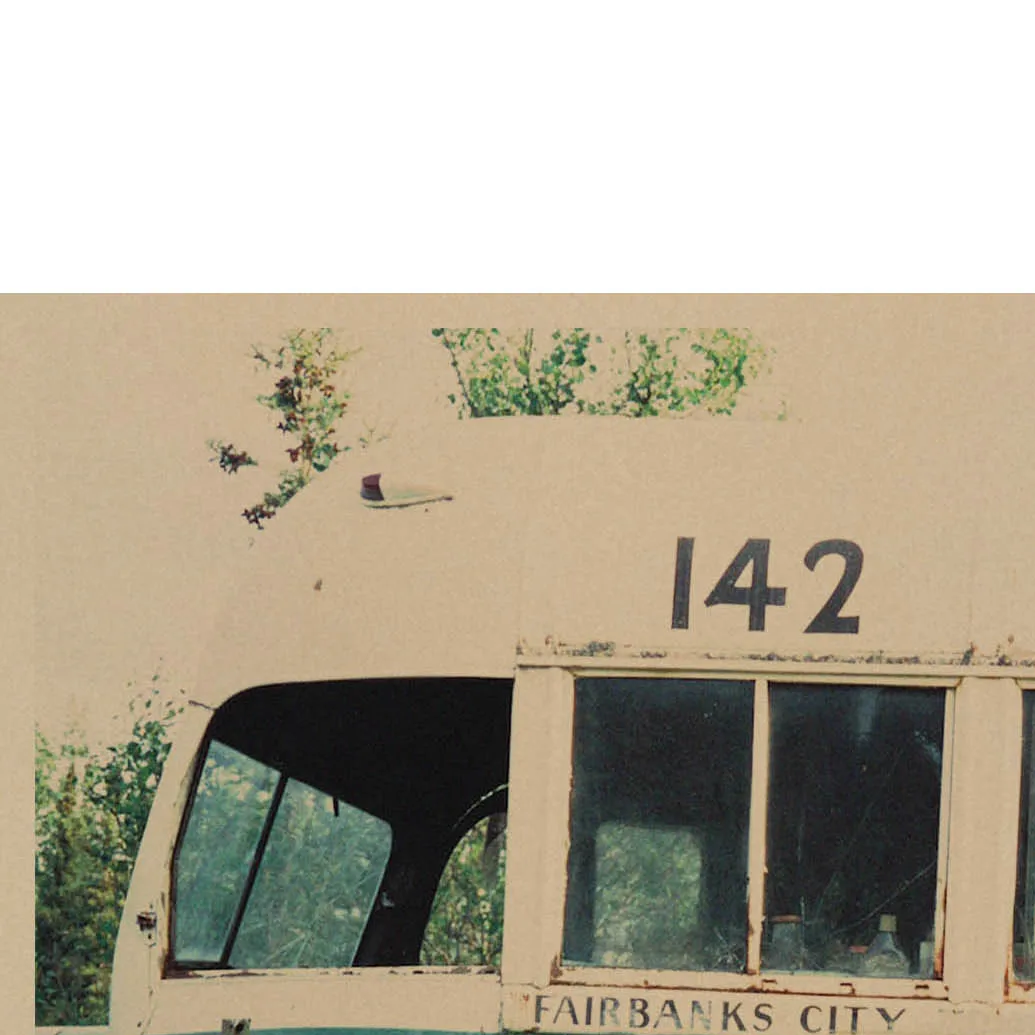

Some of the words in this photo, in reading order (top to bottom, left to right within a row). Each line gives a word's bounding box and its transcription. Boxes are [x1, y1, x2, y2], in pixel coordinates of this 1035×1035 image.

[671, 536, 864, 634] 142
[534, 995, 774, 1032] FAIRBANKS
[800, 1004, 906, 1035] CITY
